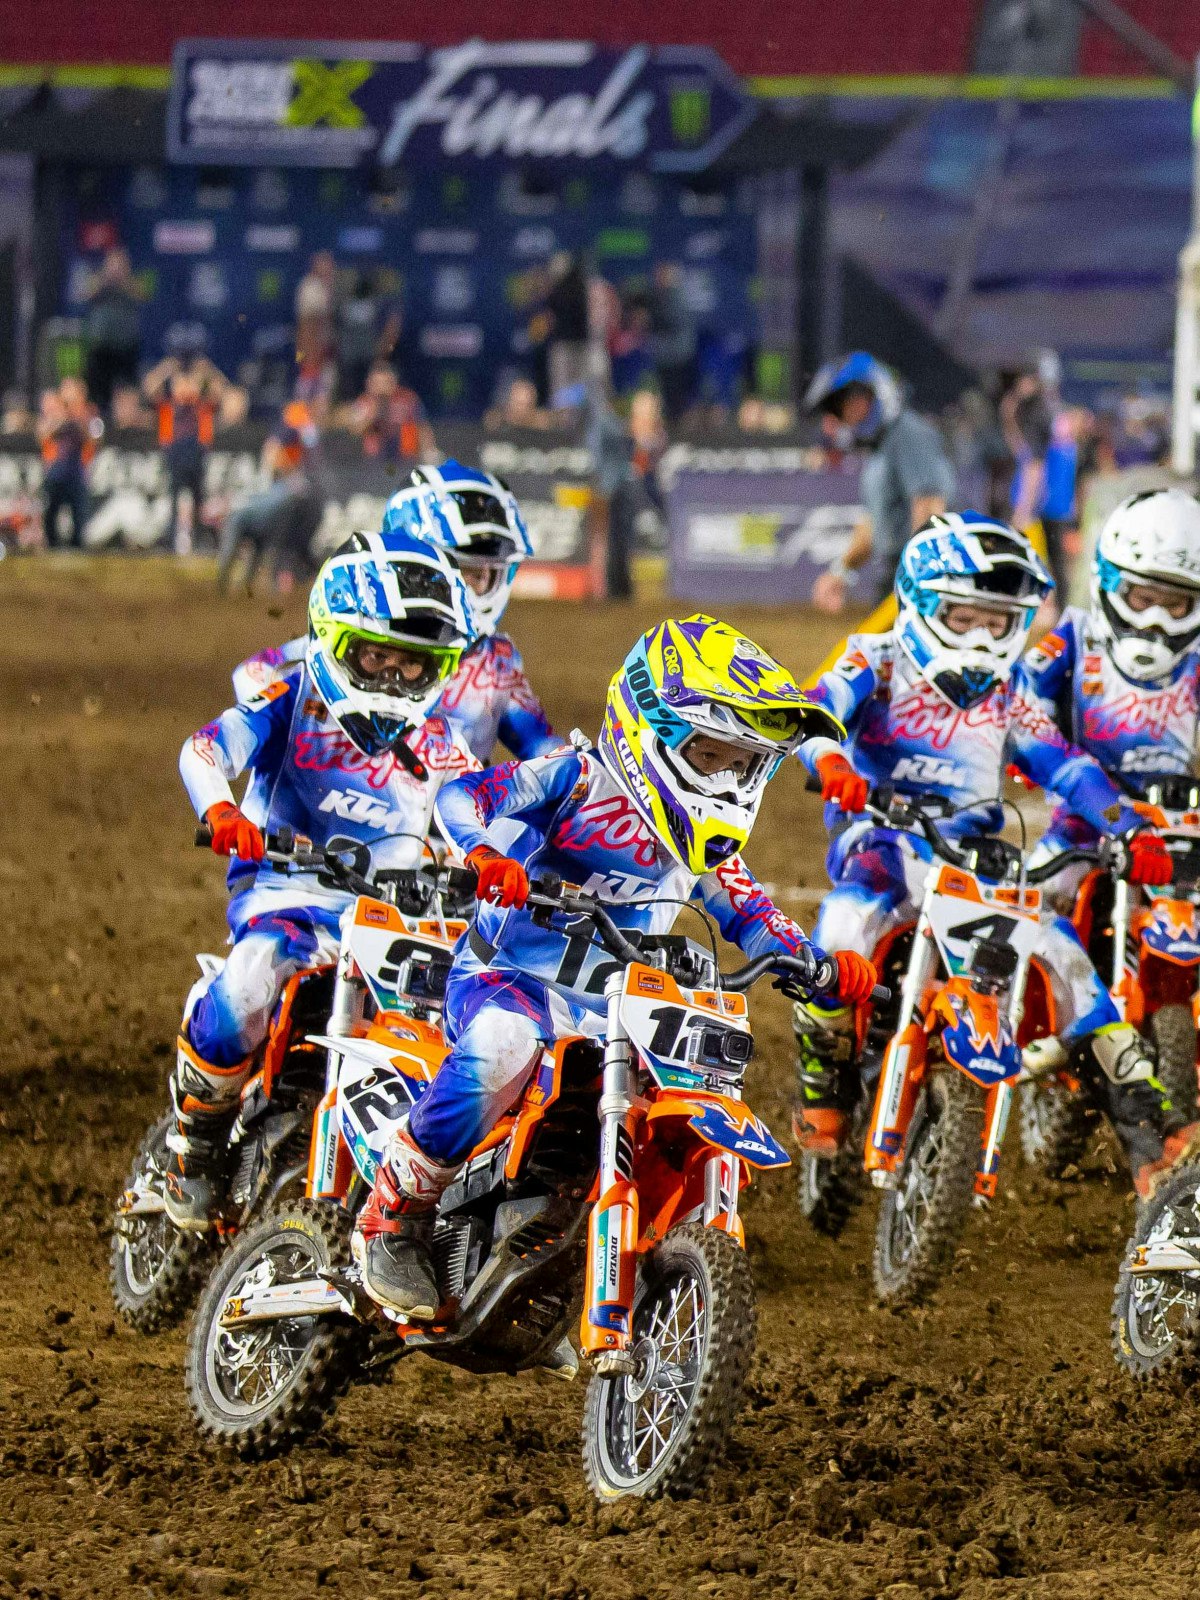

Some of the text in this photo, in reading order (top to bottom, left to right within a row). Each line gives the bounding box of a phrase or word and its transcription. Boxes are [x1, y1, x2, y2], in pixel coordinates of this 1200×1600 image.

[379, 38, 653, 166] Finals
[663, 645, 682, 677] CRC
[626, 656, 684, 738] 100%
[617, 737, 653, 810] CLIPSAL
[891, 753, 967, 787] KTM
[319, 788, 403, 834] KTM
[947, 913, 1020, 970] 4
[649, 1005, 731, 1062] 12
[343, 1067, 412, 1135] 12
[326, 1132, 337, 1180] DUNLOP
[734, 1139, 777, 1159] KTM
[607, 1236, 619, 1287] DUNLOP
